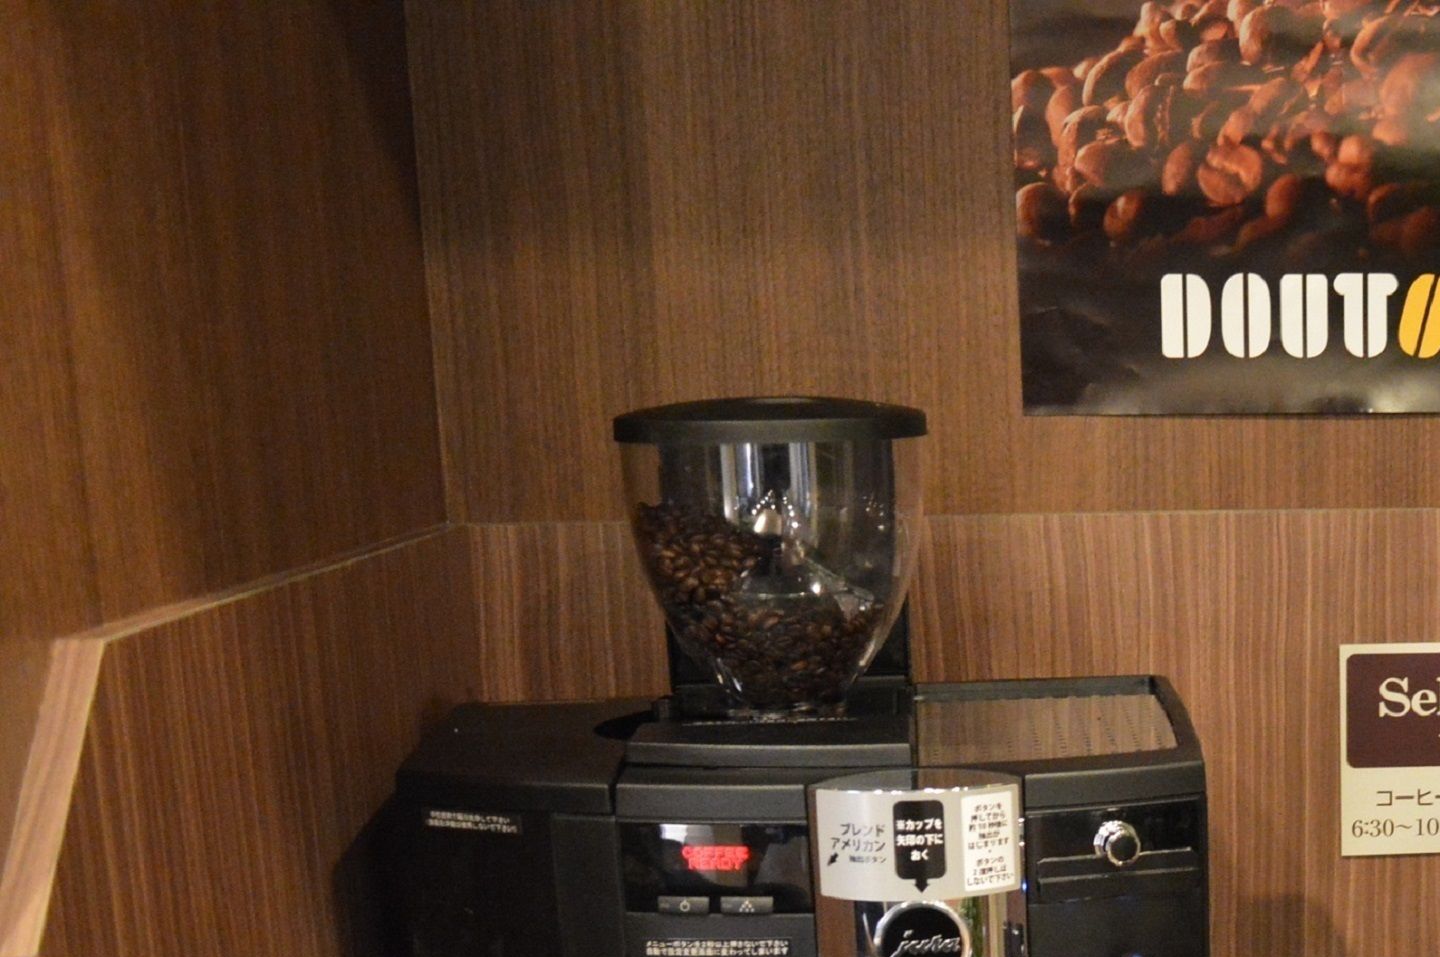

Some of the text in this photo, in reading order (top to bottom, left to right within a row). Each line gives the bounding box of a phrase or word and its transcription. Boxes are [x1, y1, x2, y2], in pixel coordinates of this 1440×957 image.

[840, 822, 887, 838] ブレンド
[830, 836, 887, 852] アメリカン
[895, 832, 944, 847] 矢印の下に
[909, 848, 930, 862] おく
